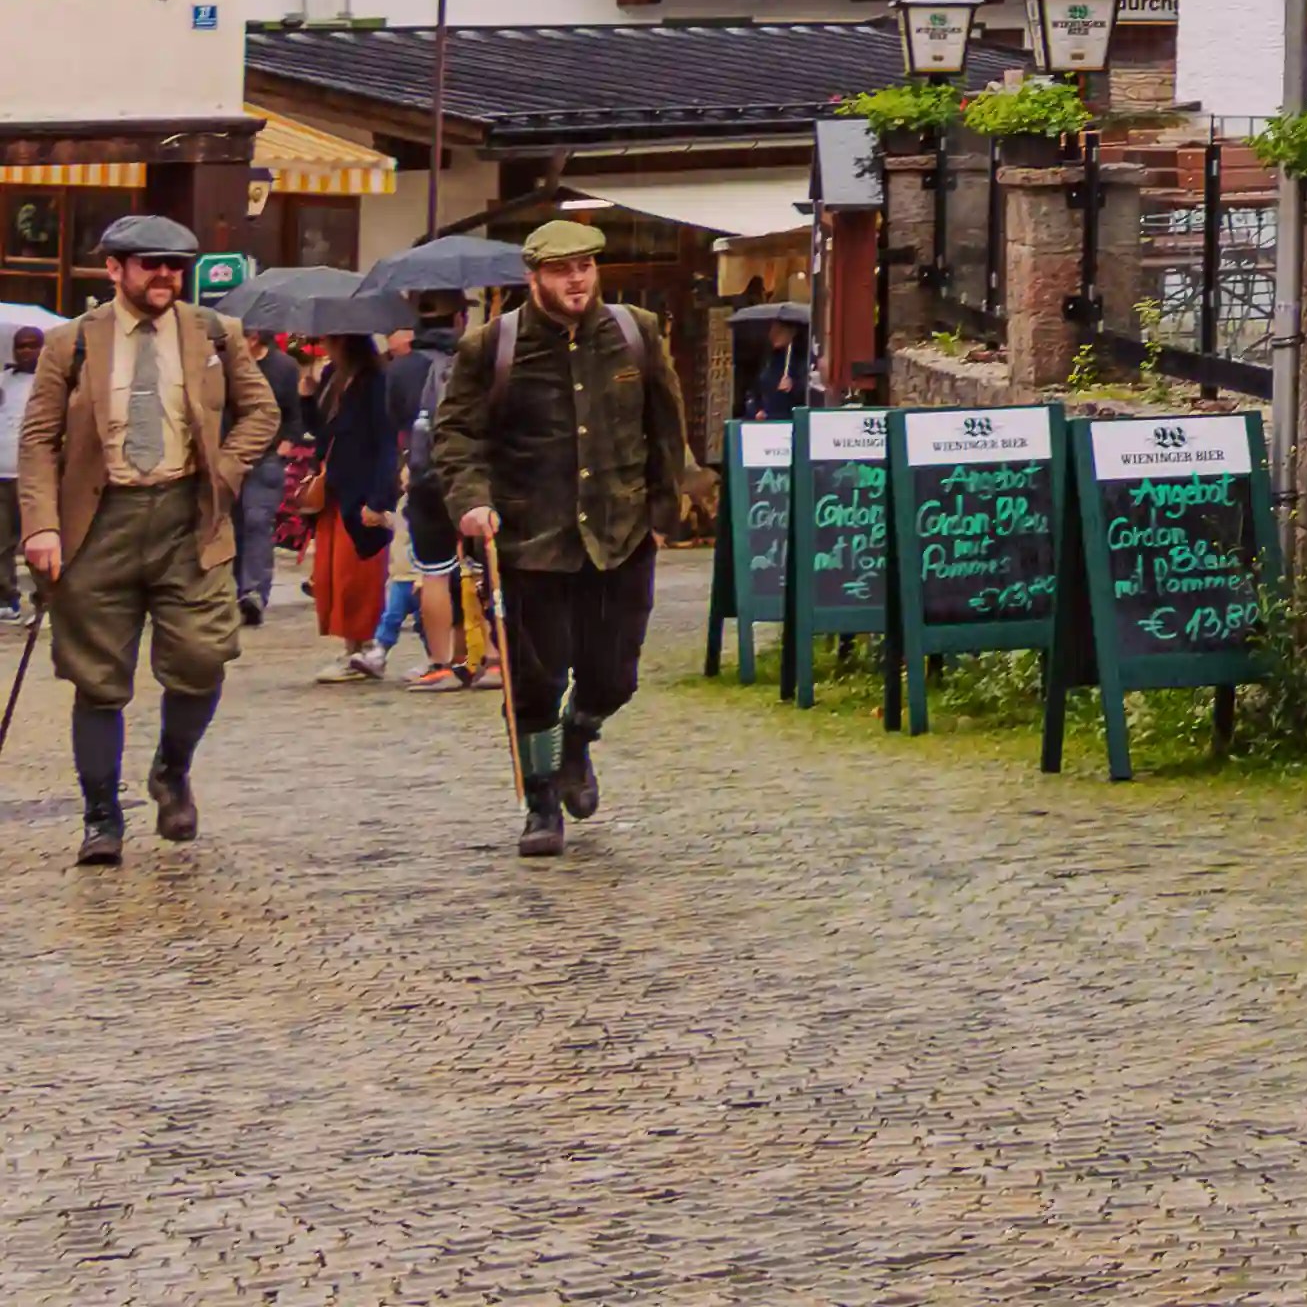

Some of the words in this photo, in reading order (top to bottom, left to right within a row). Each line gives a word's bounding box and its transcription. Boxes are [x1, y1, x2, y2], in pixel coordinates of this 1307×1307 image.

[1121, 451, 1192, 465] WIENINGER
[1195, 449, 1225, 462] BIER
[915, 494, 990, 538] Cordon
[1129, 471, 1236, 518] Angebot
[1107, 507, 1188, 550] Cordon
[922, 543, 1012, 581] Pommes
